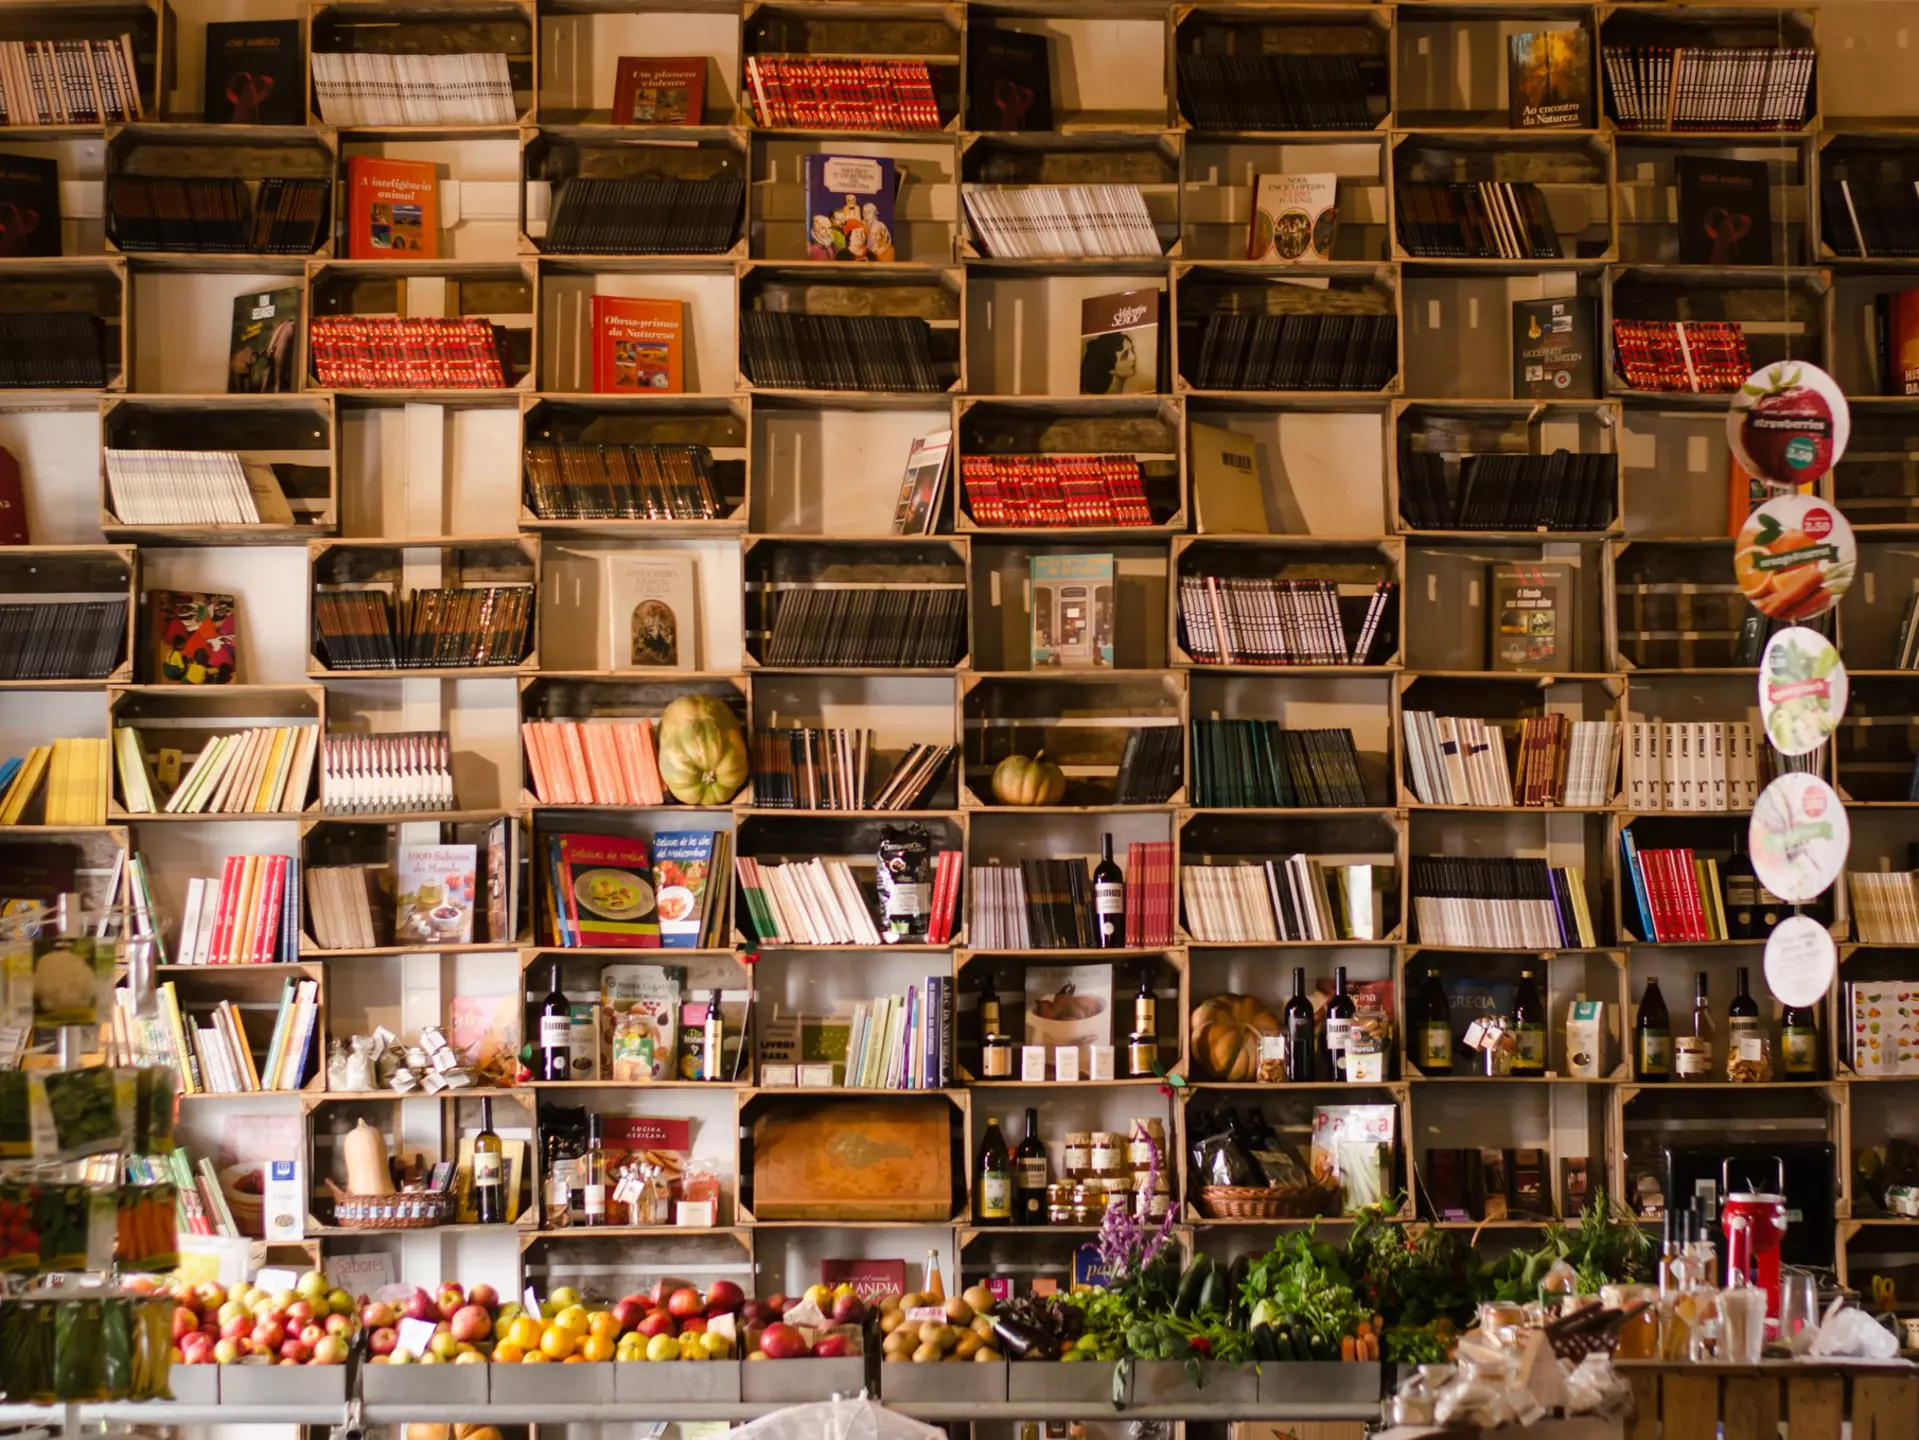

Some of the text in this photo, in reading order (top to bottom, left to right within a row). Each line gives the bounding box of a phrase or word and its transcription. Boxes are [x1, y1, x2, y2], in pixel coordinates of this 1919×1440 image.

[654, 70, 696, 79] planeta
[1523, 103, 1580, 116] Ao encontro
[1523, 114, 1579, 125] da Natureza
[377, 190, 416, 200] animal
[604, 315, 679, 329] Obras-primas
[608, 327, 675, 339] da Natureza
[428, 863, 461, 873] Mundo
[760, 1041, 795, 1049] LIVROS
[761, 1052, 789, 1060] PARA
